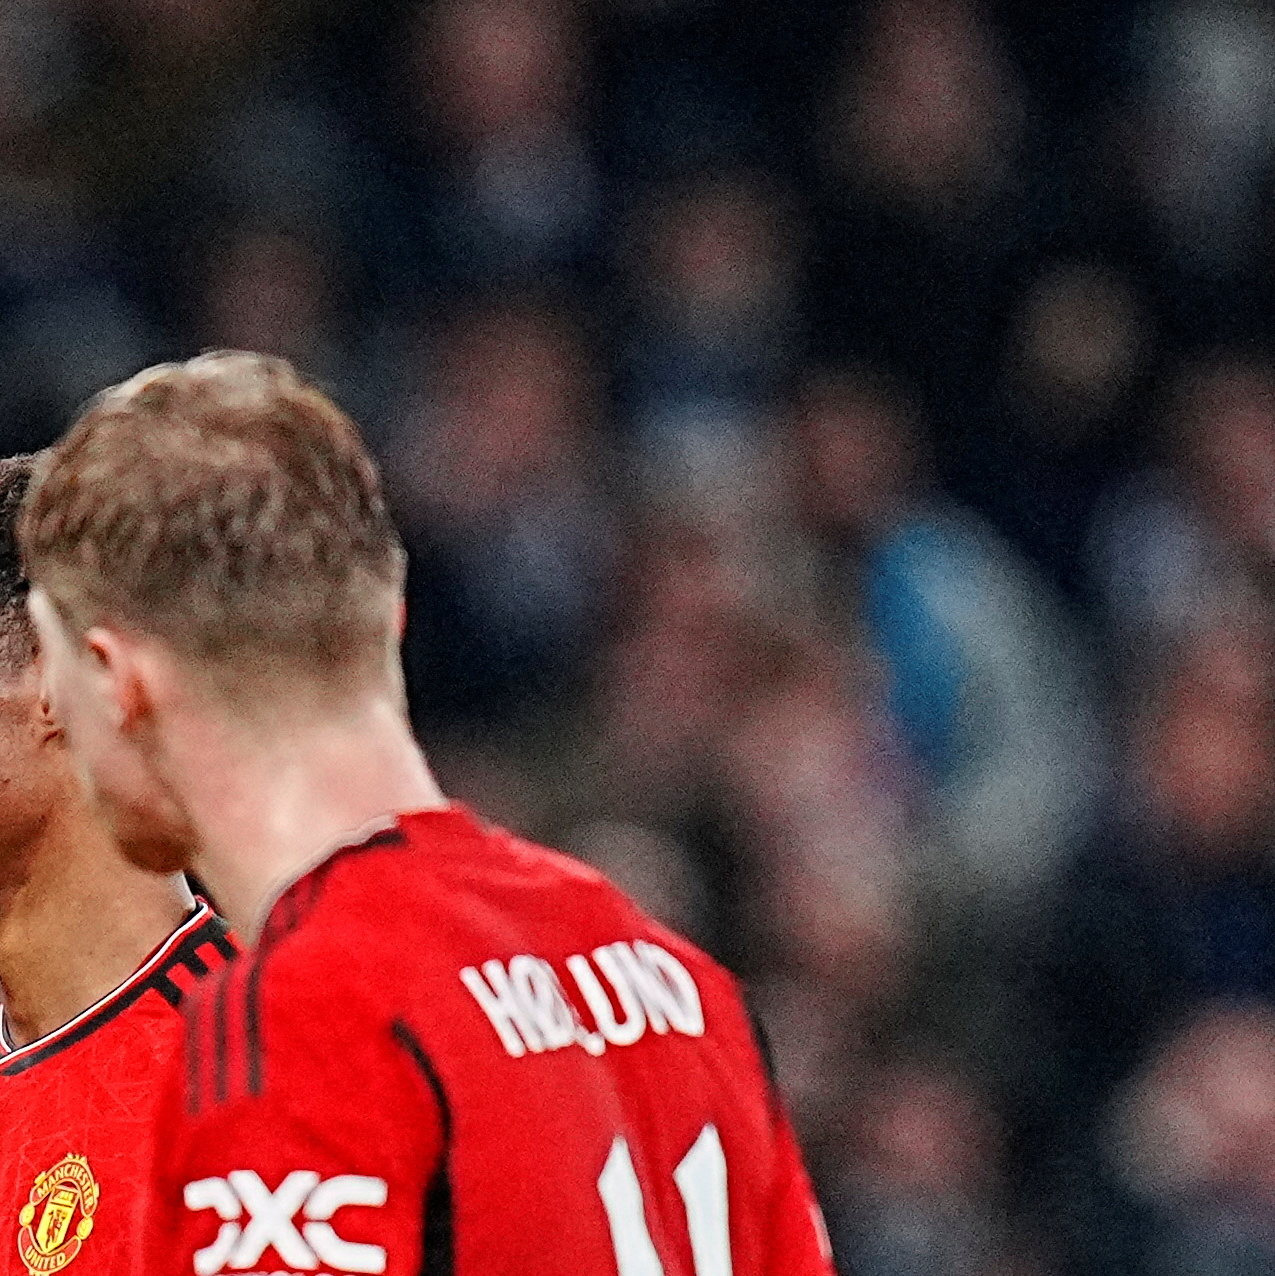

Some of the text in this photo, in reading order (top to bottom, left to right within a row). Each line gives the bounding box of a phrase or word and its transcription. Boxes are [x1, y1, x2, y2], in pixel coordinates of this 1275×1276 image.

[36, 1163, 95, 1209] MANCHESTER
[183, 1169, 389, 1276] DXC
[25, 1244, 66, 1270] UNITED
